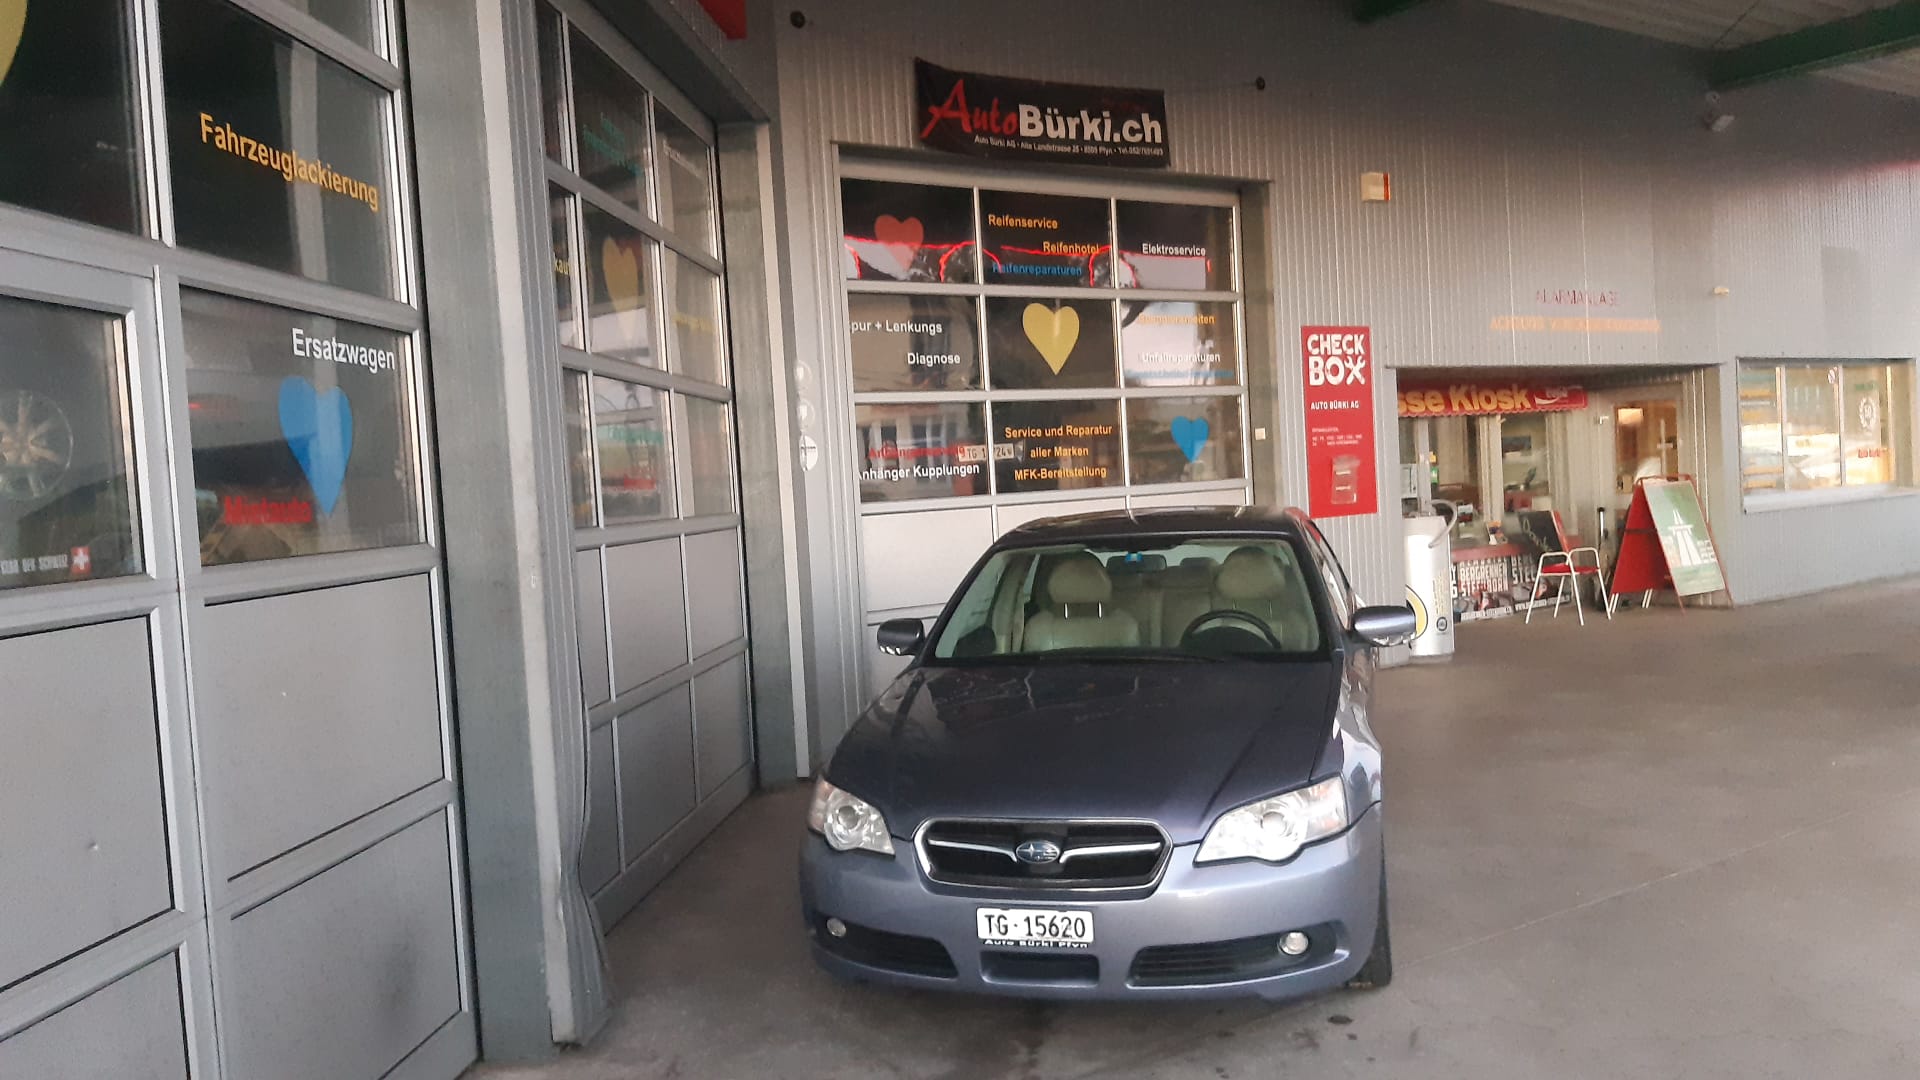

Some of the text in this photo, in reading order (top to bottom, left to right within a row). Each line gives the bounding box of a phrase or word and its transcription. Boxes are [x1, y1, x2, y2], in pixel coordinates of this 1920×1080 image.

[200, 112, 379, 212] Fahrzeuglackierung
[988, 214, 1058, 229] Reifenservice
[1043, 241, 1099, 255] Reifenhotel
[1142, 243, 1206, 256] Elektroservice
[992, 261, 1082, 276] Reifenreparaturen
[885, 320, 943, 335] Lenkungs
[292, 327, 396, 373] Ersatzwagen
[1307, 333, 1365, 355] CHECK
[907, 353, 960, 367] Diagnose
[1308, 355, 1366, 386] BOX
[1311, 400, 1359, 410] AUTO BÜRKI AG
[1450, 384, 1532, 412] Kiosk
[1005, 425, 1113, 438] Service und Reparatur
[1030, 446, 1089, 458] aller Marken
[913, 465, 980, 478] Kupplungen
[1014, 467, 1107, 480] MFK-Bereitstellung
